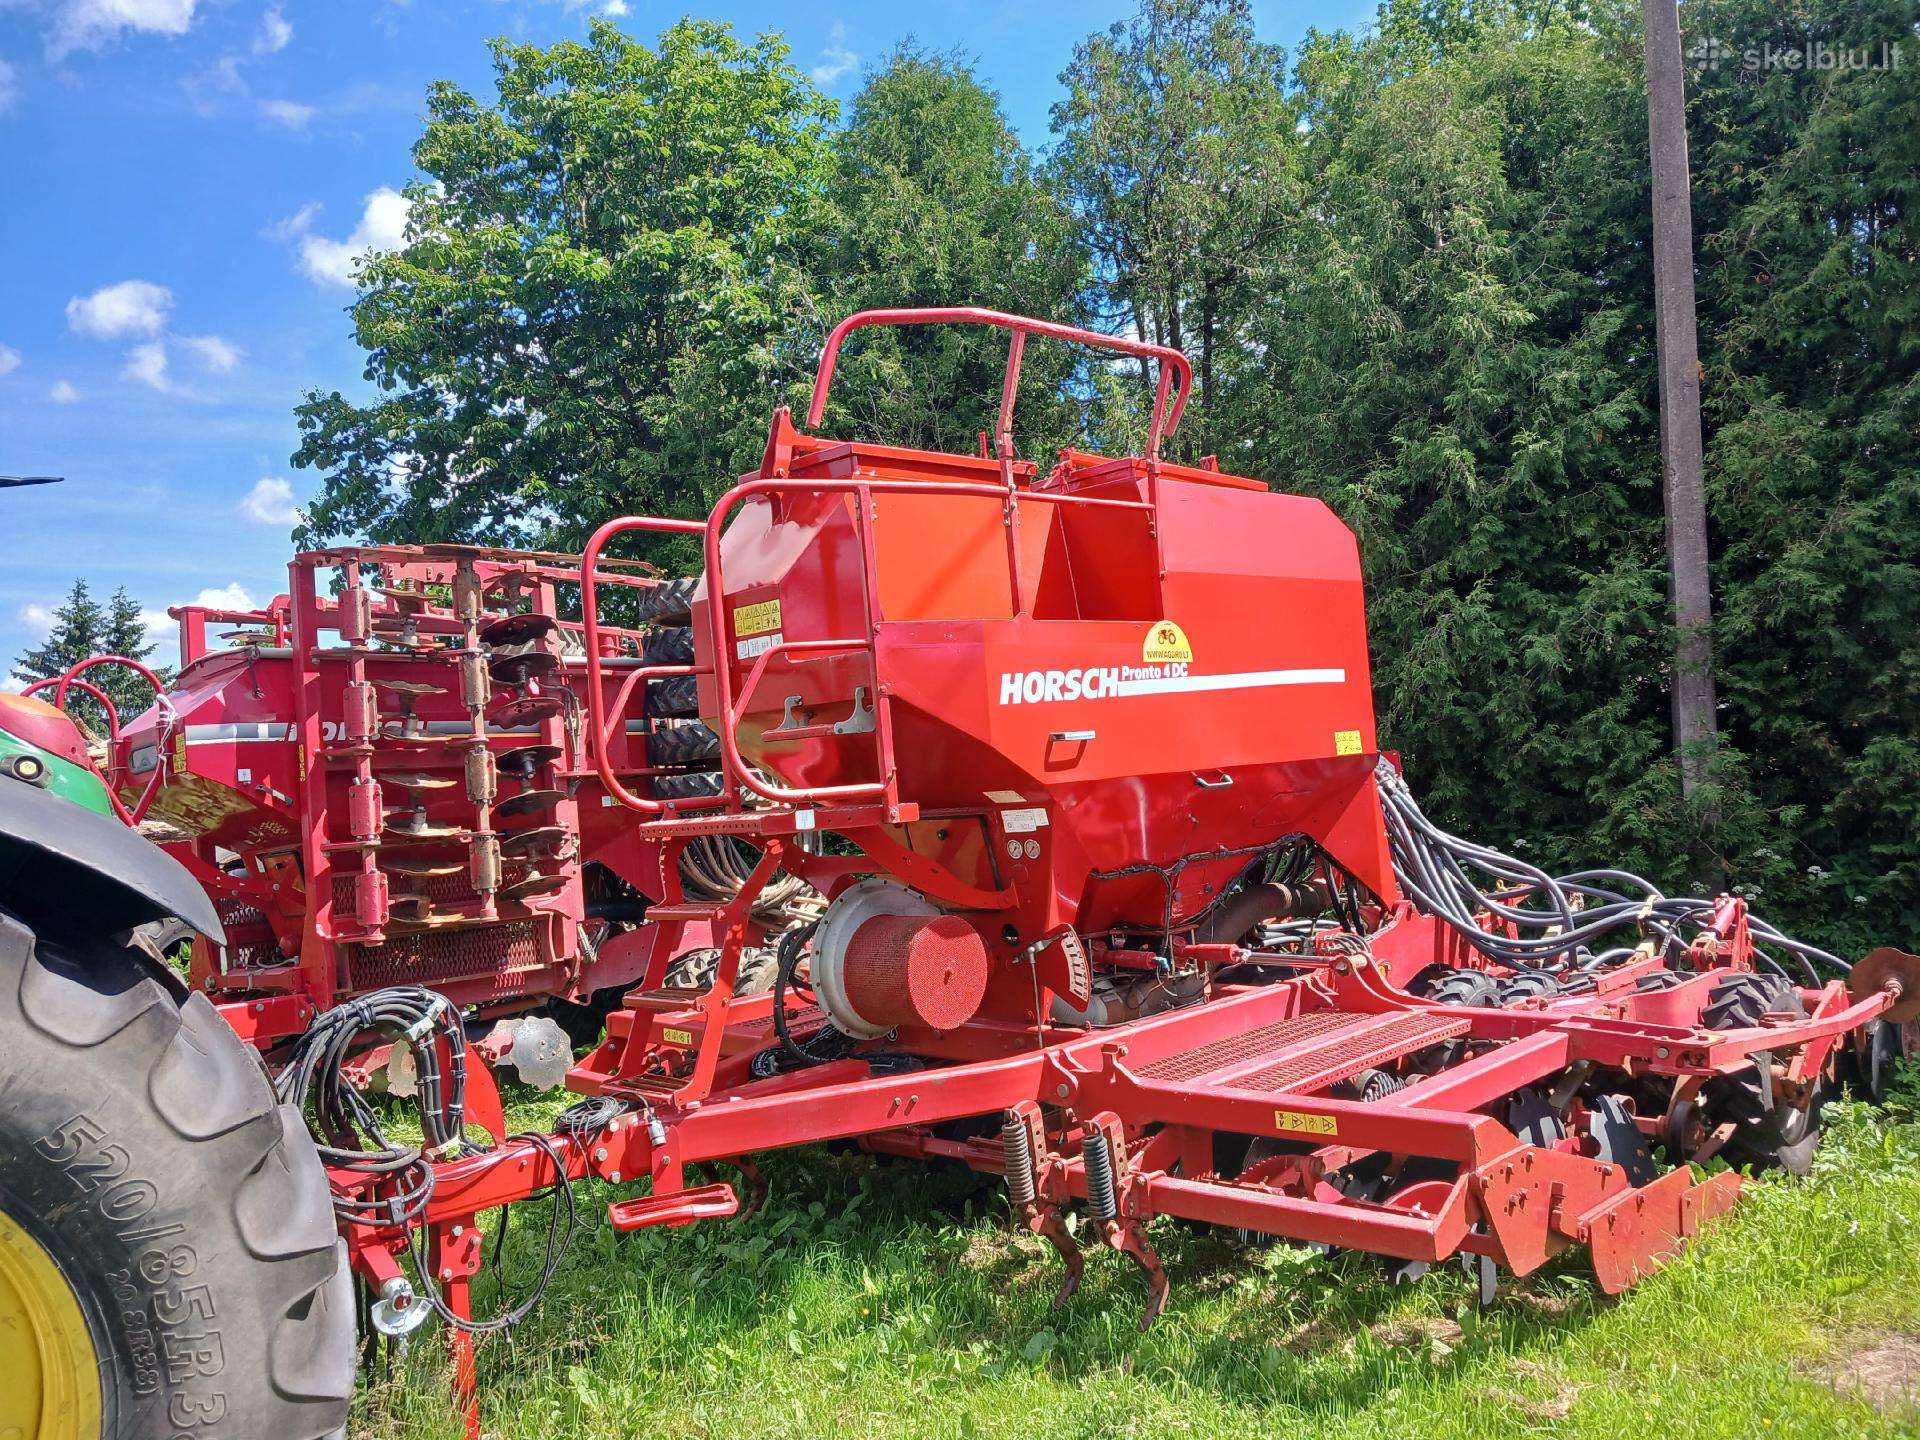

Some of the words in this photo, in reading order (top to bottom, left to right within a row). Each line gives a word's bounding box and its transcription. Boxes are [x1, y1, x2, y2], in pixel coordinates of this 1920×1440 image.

[999, 666, 1119, 706] HORSCH
[1121, 665, 1161, 681] Pronto
[1163, 663, 1171, 678] 4
[1172, 661, 1189, 678] DC
[32, 1113, 227, 1440] 520/85R3
